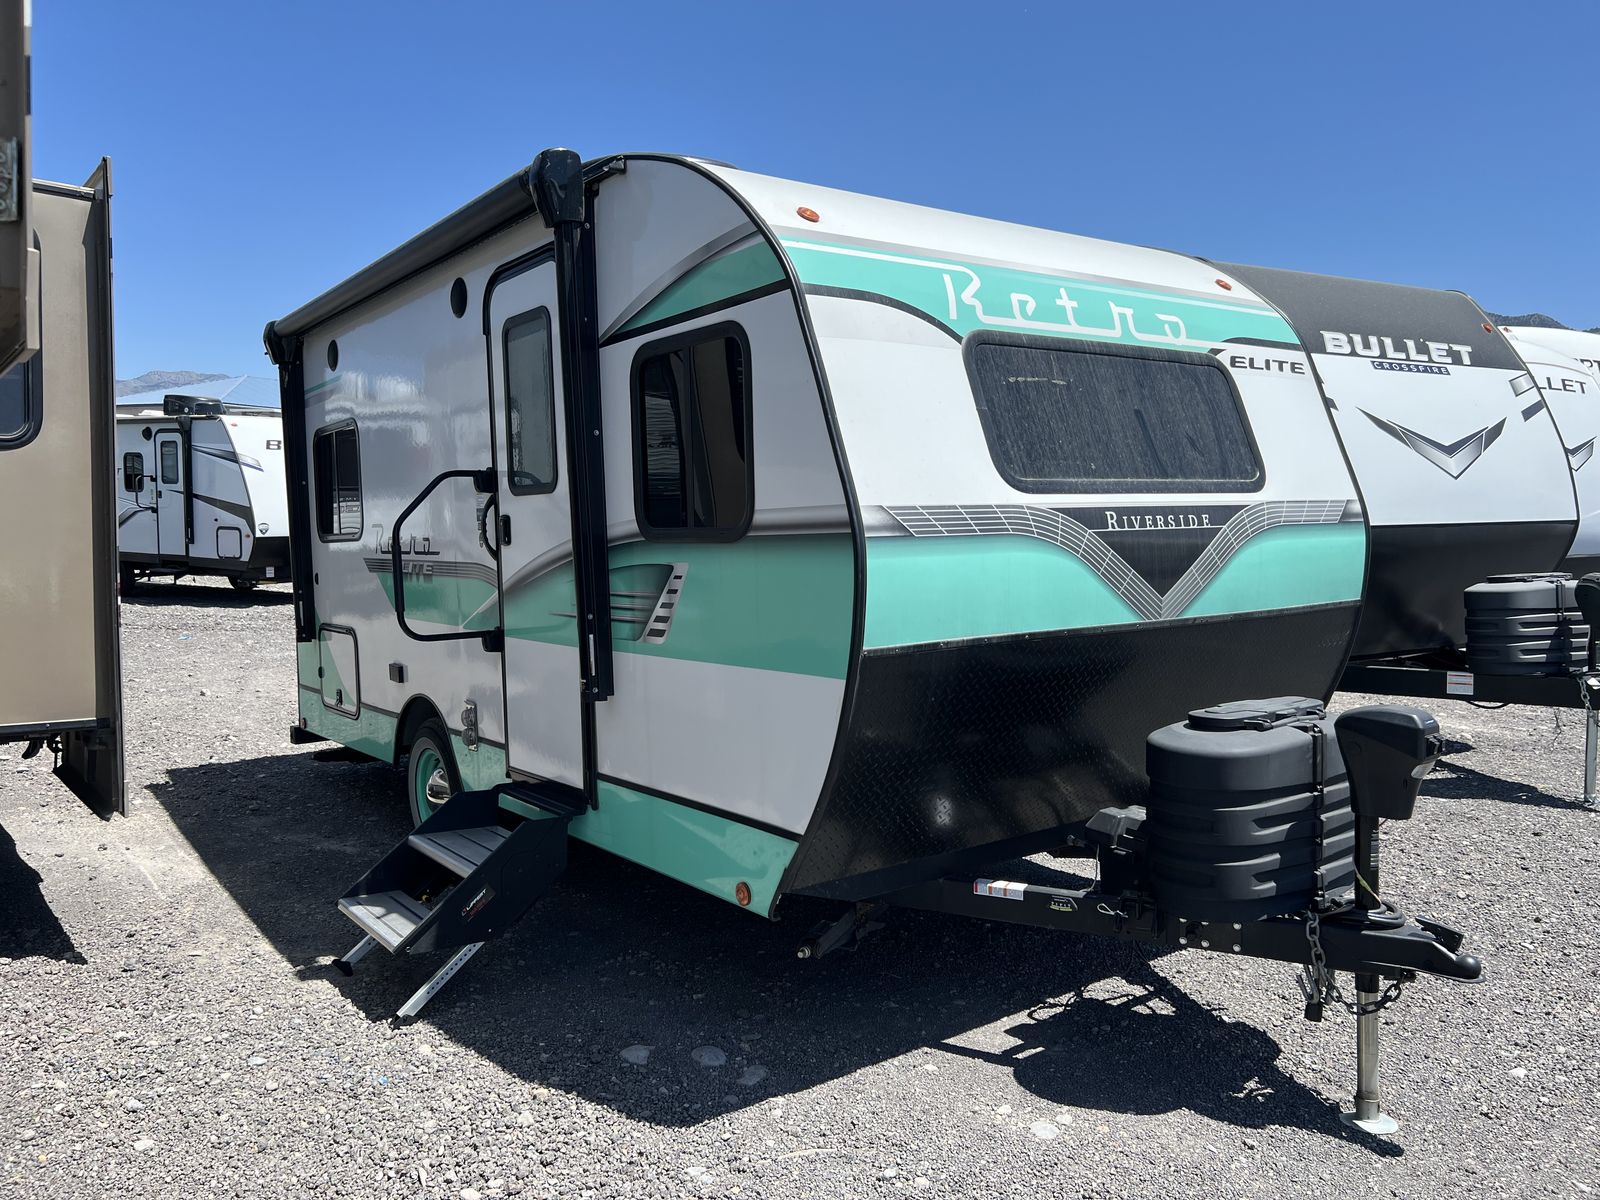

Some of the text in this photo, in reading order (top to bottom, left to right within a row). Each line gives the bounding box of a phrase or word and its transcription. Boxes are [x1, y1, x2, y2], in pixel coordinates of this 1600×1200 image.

[942, 265, 1189, 346] Retro
[1319, 330, 1473, 366] BULLET
[1229, 355, 1306, 375] ELITE
[1373, 361, 1450, 376] CROSSFIRE
